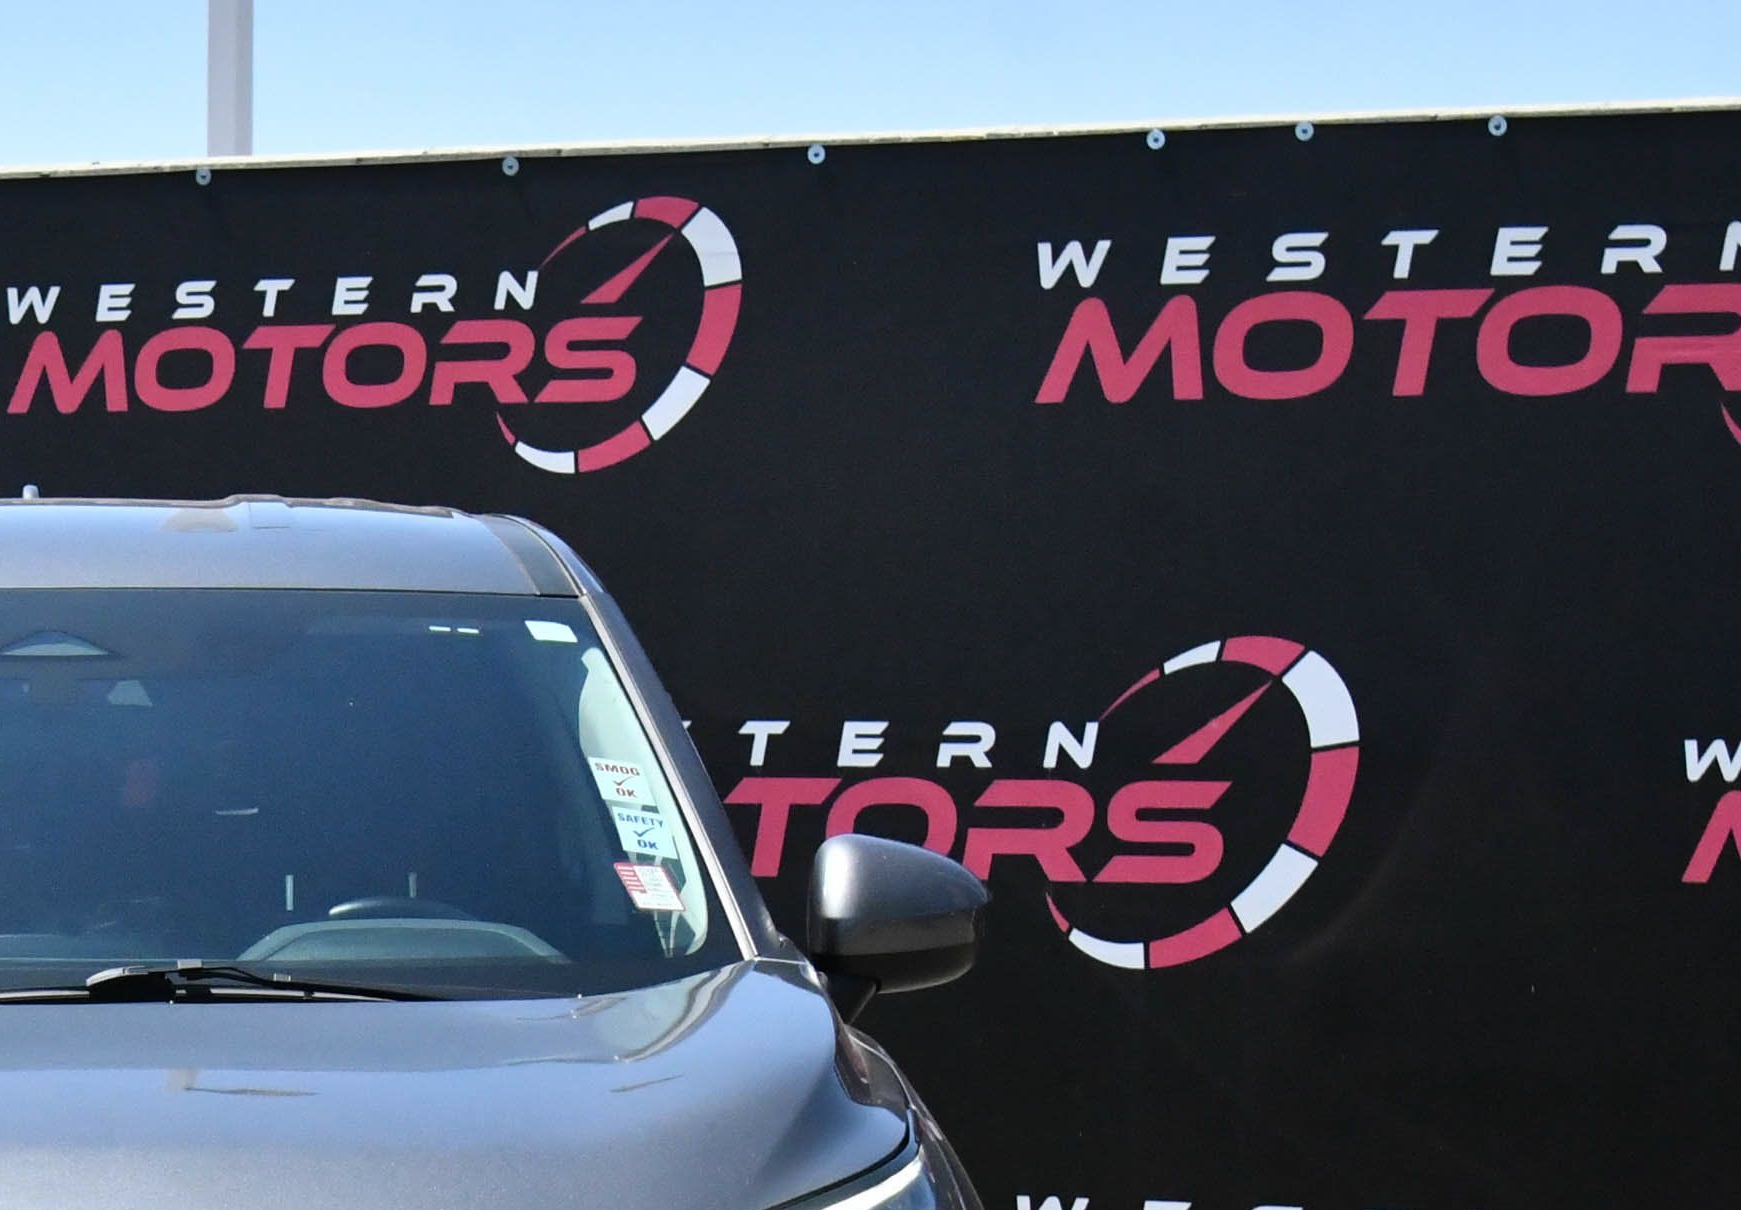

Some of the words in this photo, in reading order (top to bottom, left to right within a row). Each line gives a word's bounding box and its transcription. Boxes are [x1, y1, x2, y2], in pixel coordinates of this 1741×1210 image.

[6, 270, 539, 325] WESTERN
[7, 316, 643, 414] MOTORS
[682, 720, 1099, 769] TERN
[595, 762, 640, 776] SMOG
[615, 787, 637, 798] OK
[617, 813, 663, 828] SAFETY
[723, 776, 1233, 884] TORS
[637, 839, 659, 850] OK
